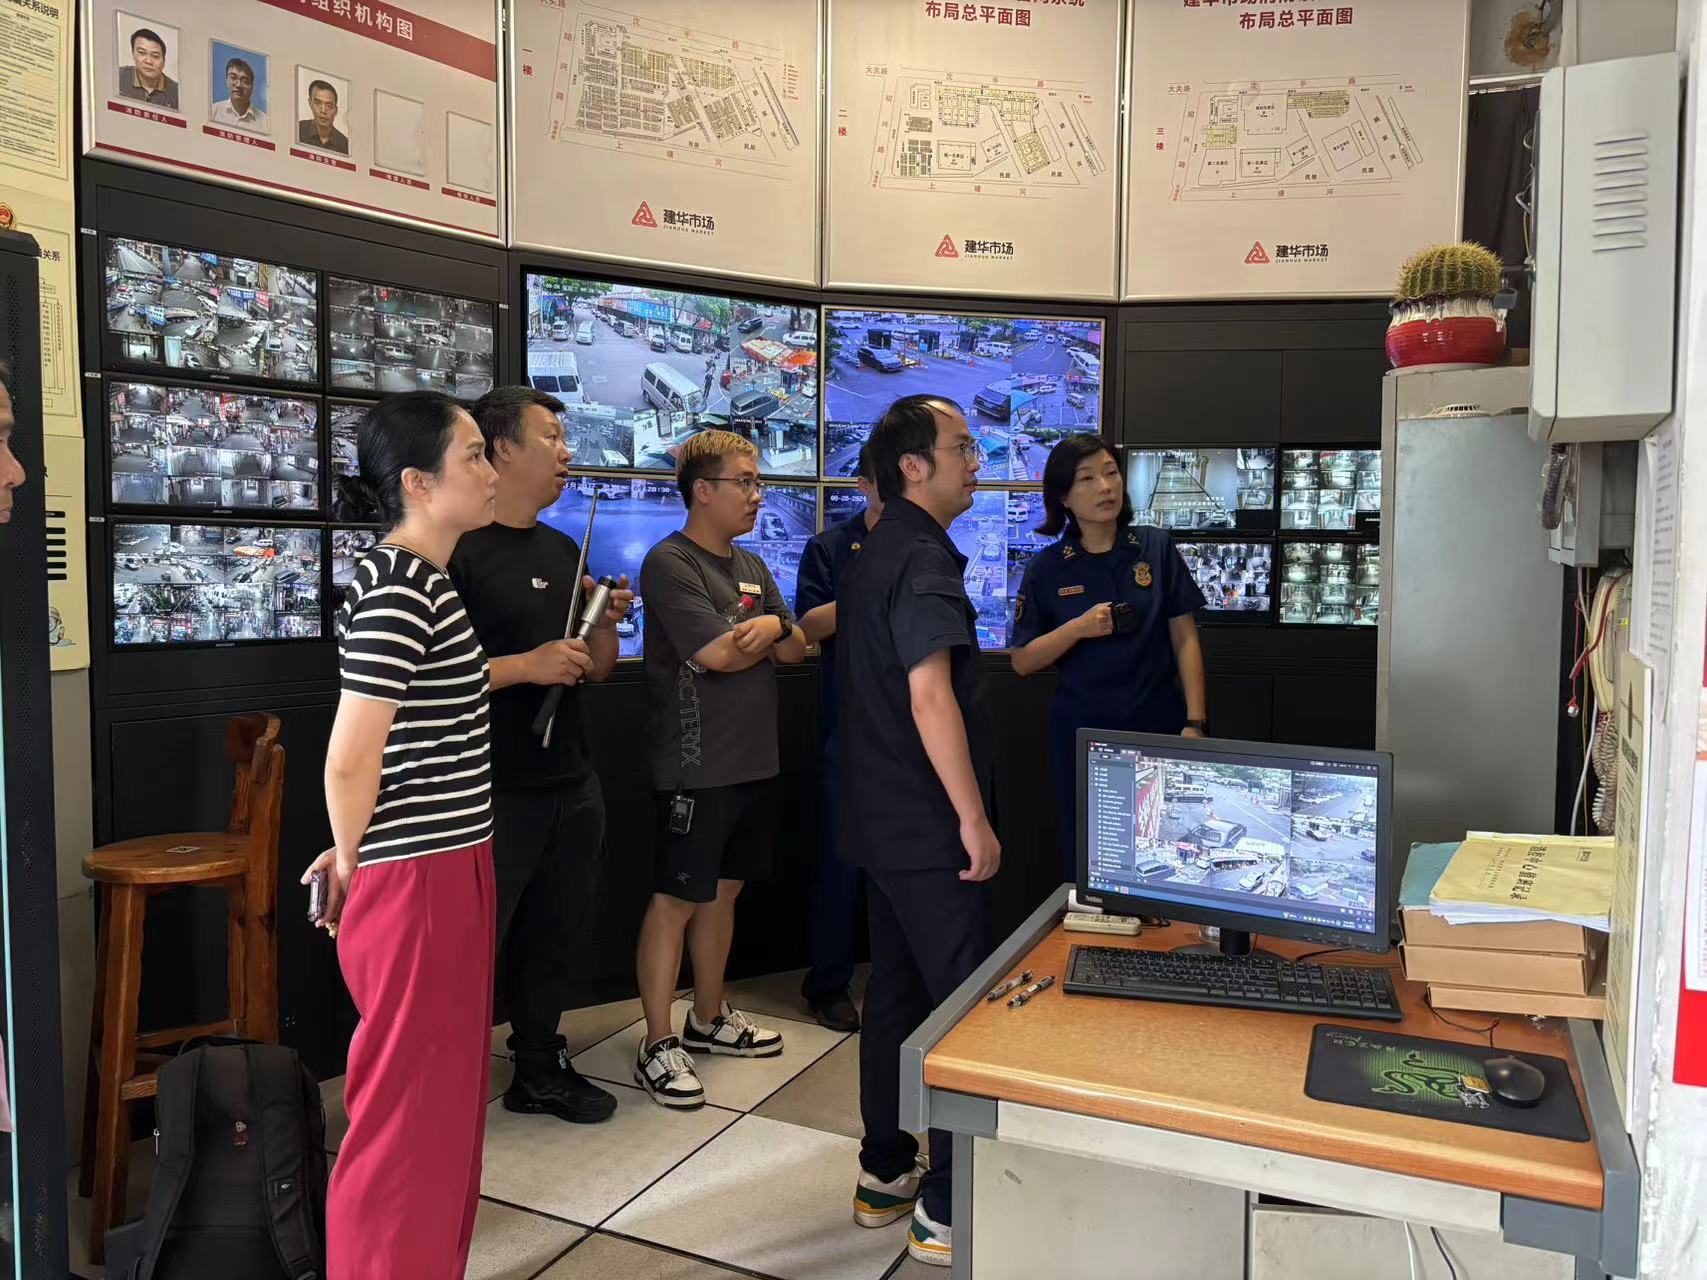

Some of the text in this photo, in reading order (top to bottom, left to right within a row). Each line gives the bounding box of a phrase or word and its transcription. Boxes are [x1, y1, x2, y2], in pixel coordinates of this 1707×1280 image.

[300, 0, 413, 41] 组织机构图
[925, 1, 1031, 27] 布局总平面图
[1239, 7, 1353, 30] 布局总平面图
[1156, 127, 1165, 150] 三楼
[663, 209, 715, 230] 建华市场
[965, 239, 1014, 255] 建华市场
[1276, 244, 1329, 257] 建华市场
[679, 665, 701, 768] RC'TERYX
